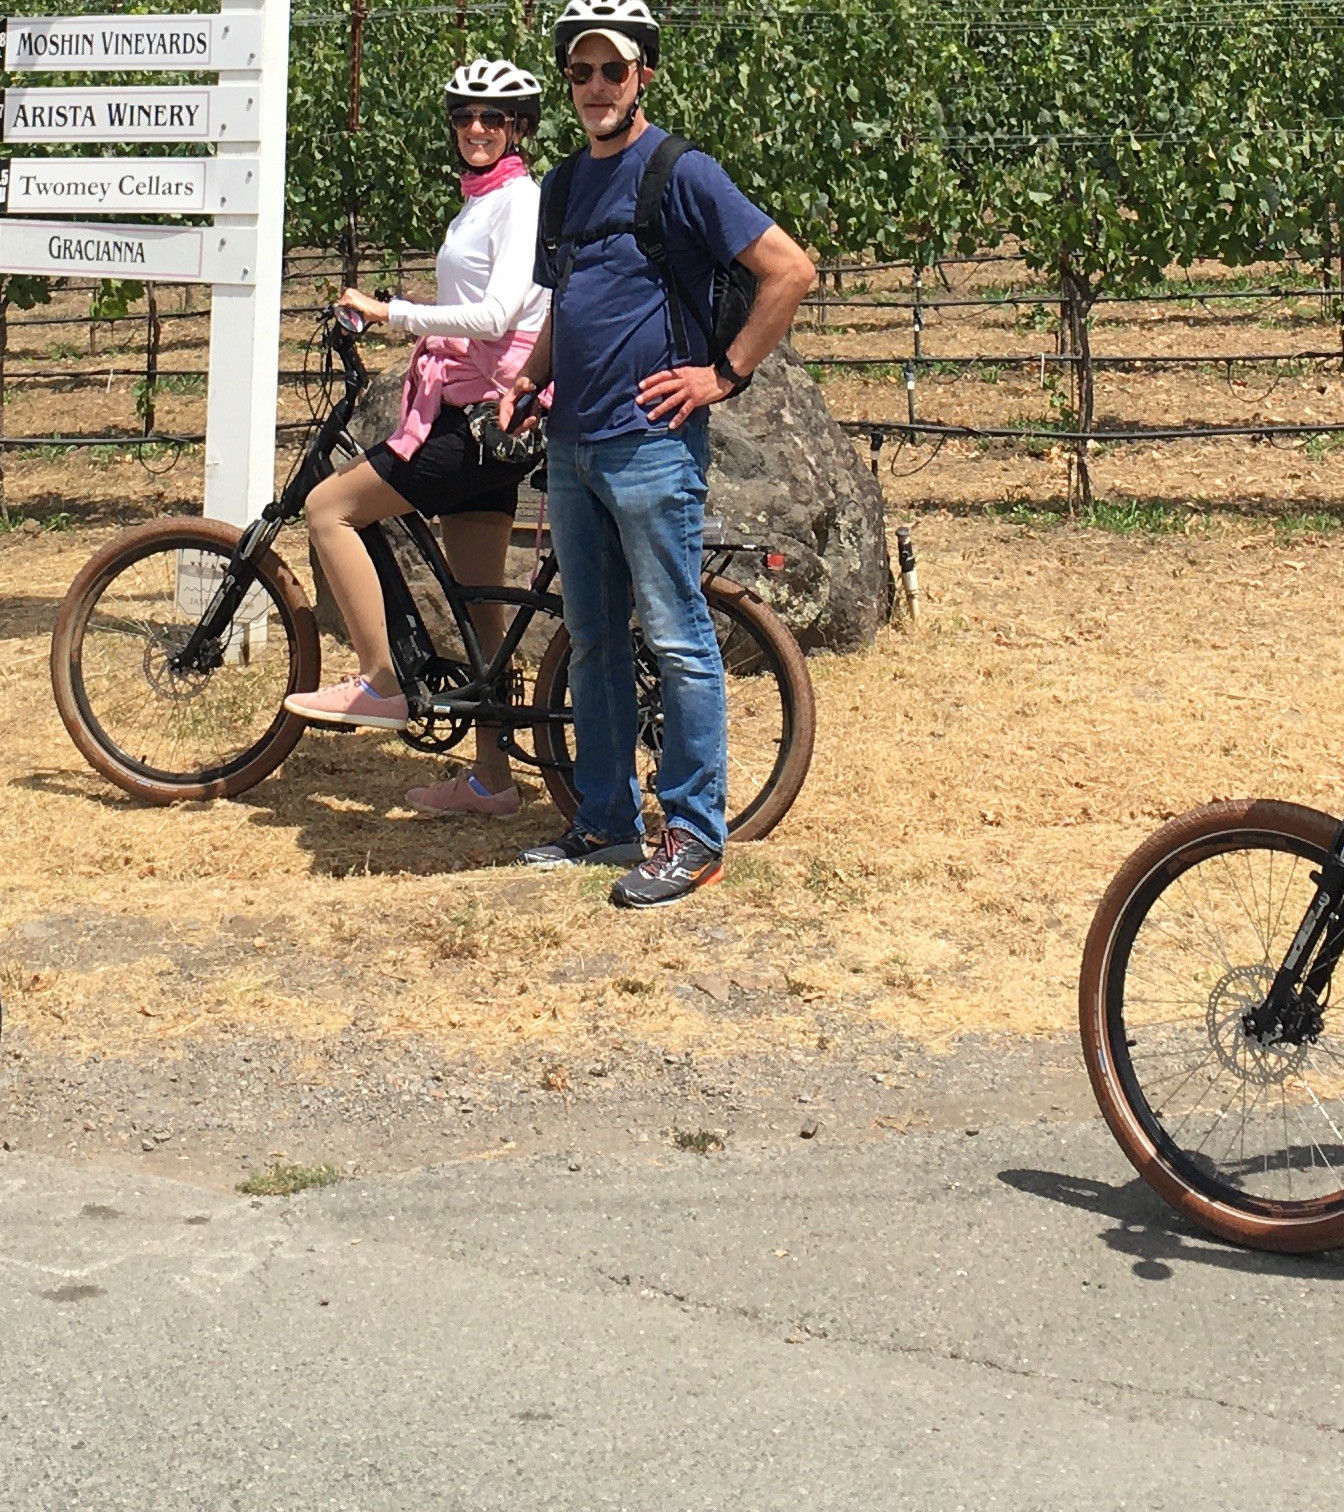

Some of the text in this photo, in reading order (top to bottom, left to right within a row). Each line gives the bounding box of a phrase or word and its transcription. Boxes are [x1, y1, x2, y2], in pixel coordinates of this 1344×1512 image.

[17, 32, 207, 56] MOSHIN VINEYARDS
[12, 103, 199, 127] ARISTA WINERY
[19, 175, 193, 202] Twomey Cellars
[49, 236, 145, 263] GRACIANNA
